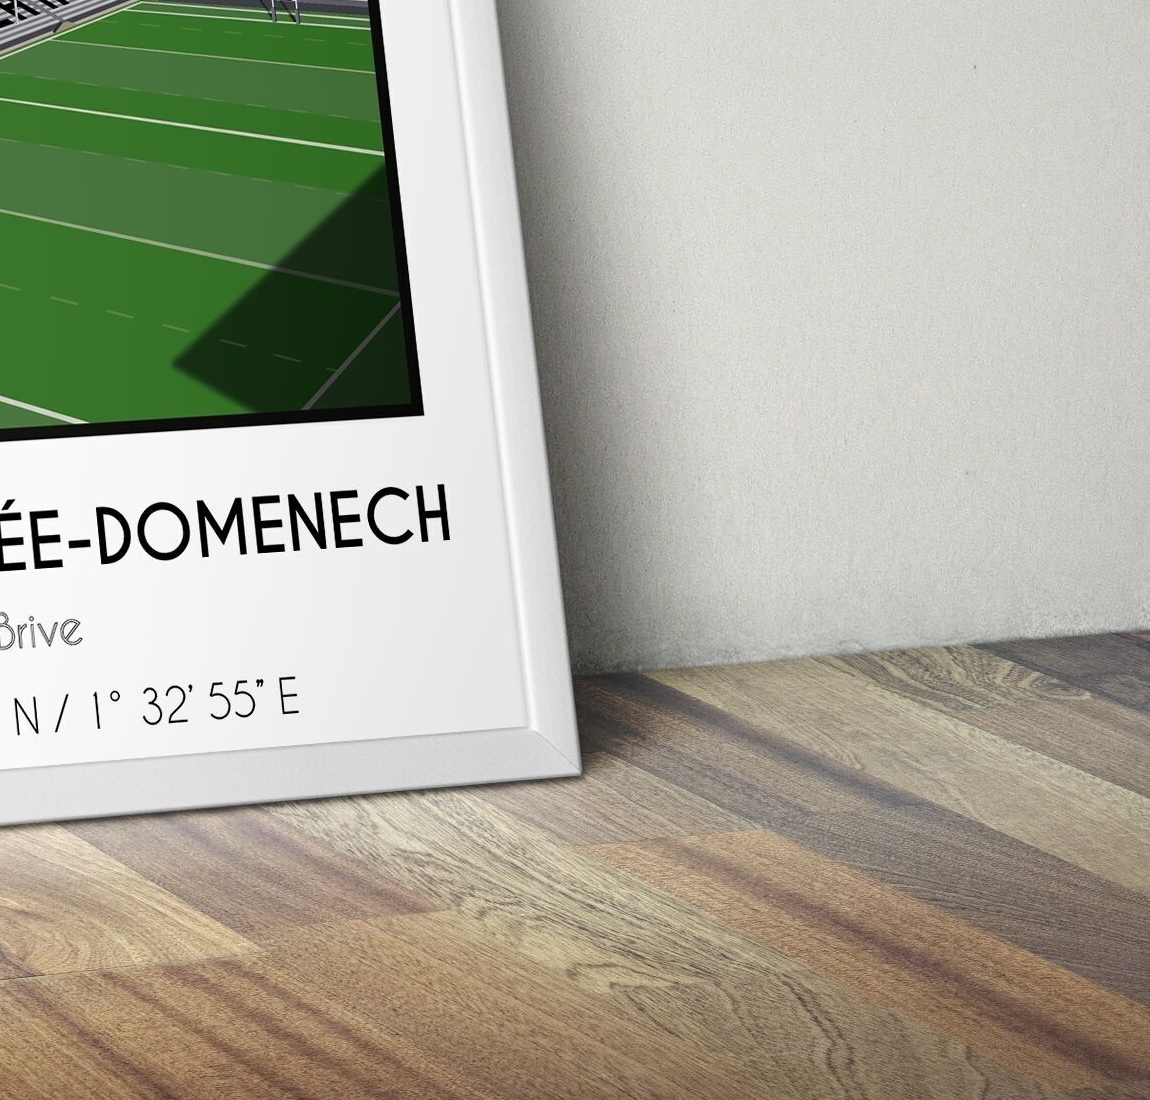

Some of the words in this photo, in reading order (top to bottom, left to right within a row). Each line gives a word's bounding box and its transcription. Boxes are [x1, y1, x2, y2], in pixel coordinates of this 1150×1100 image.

[13, 696, 40, 736] N
[54, 693, 69, 733] /
[92, 690, 121, 730] 1°
[278, 675, 300, 715] E
